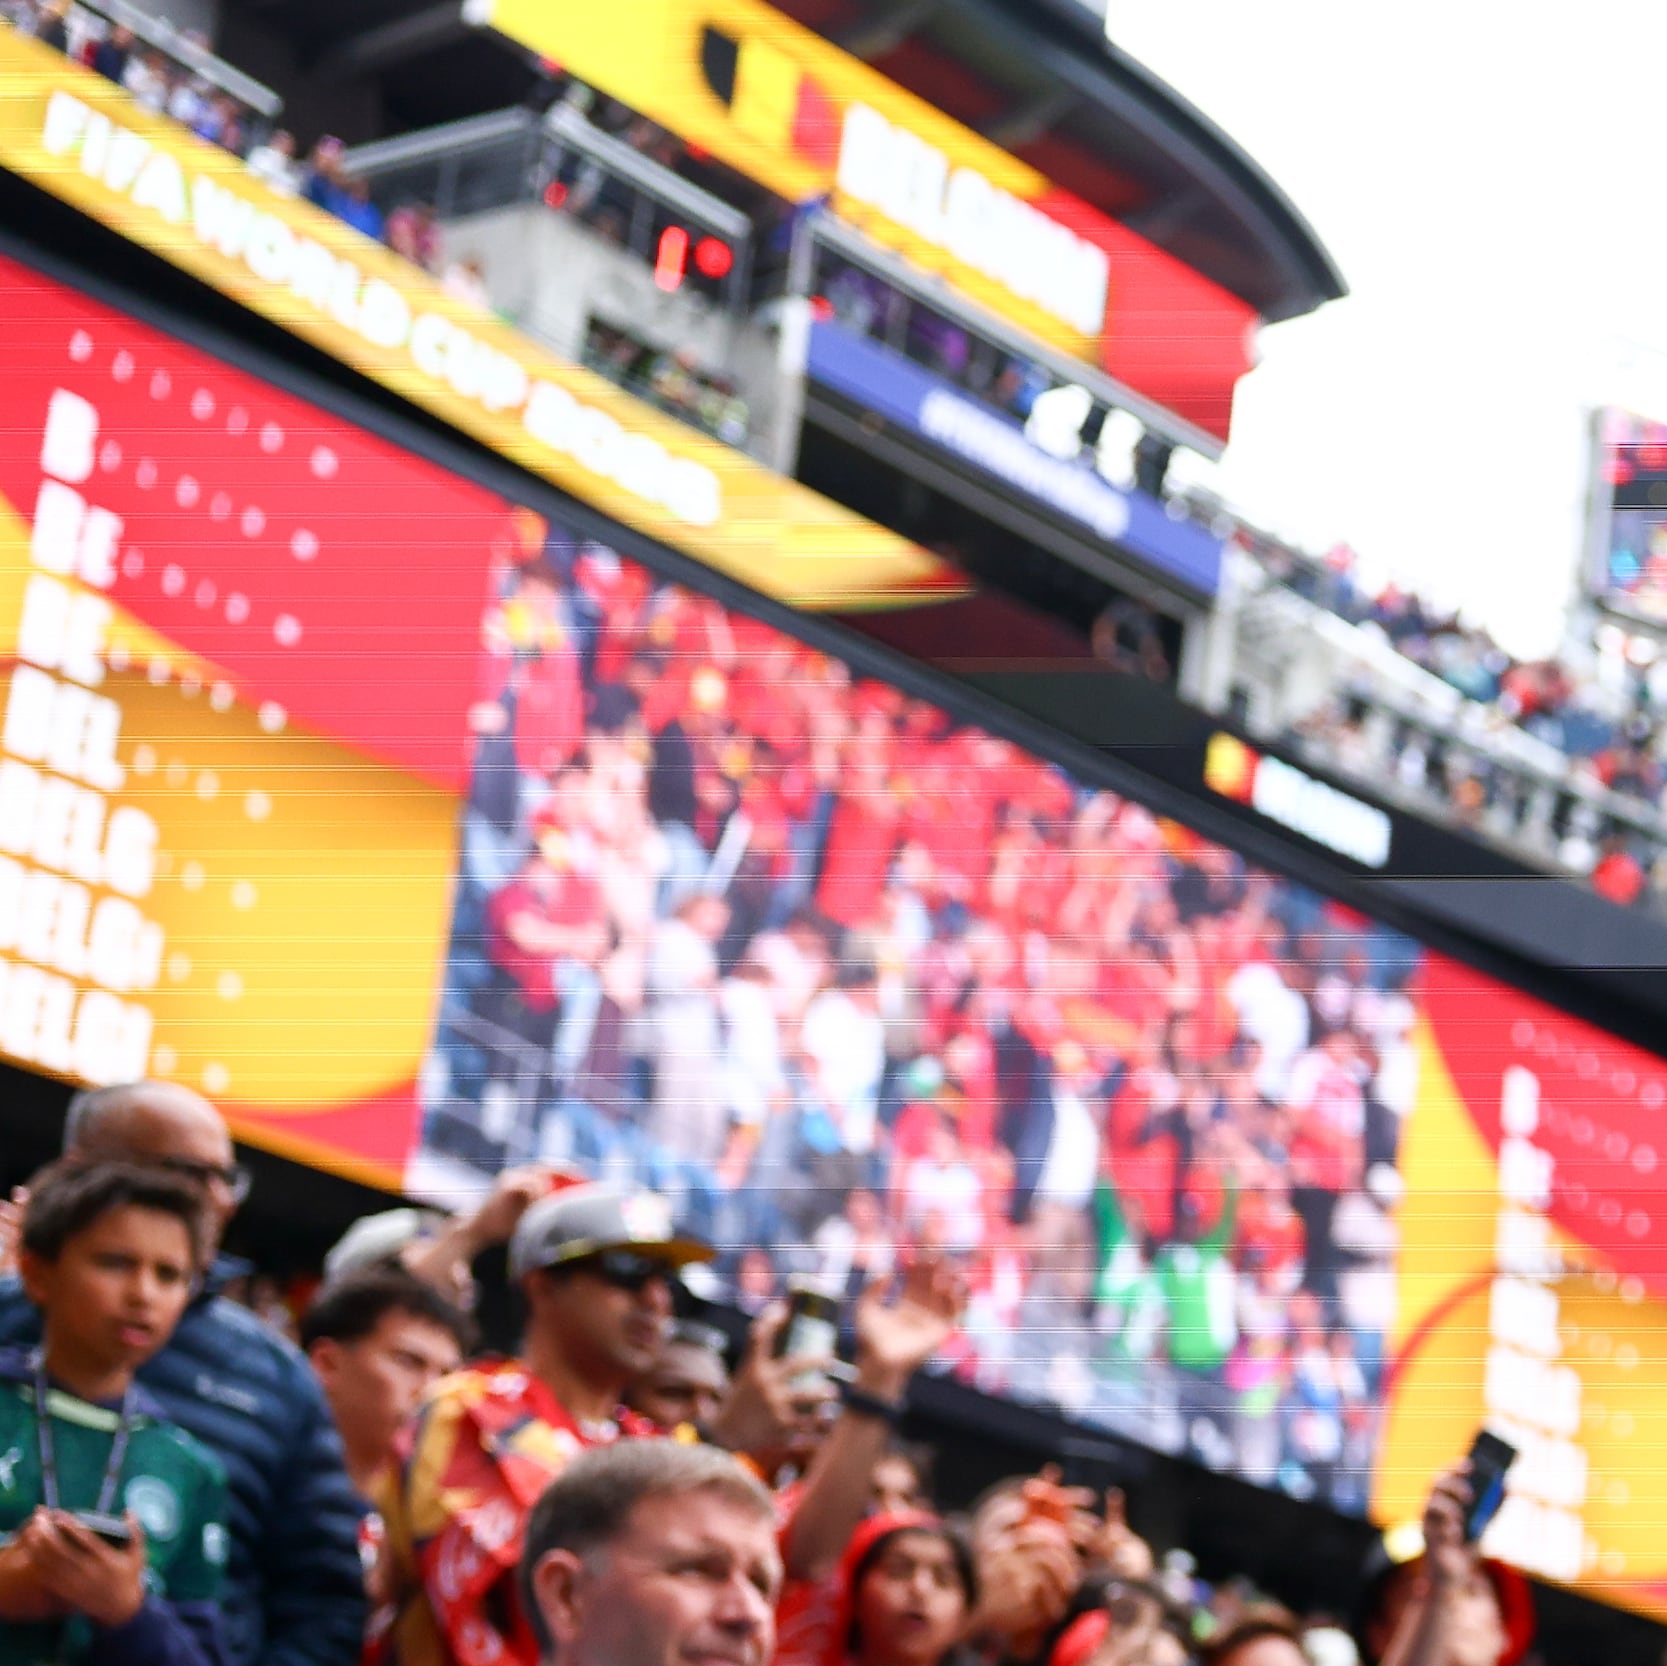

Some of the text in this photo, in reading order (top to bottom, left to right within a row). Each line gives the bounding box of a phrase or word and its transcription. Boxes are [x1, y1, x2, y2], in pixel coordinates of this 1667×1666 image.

[45, 90, 186, 224] FIFA
[192, 175, 411, 348] WORLD
[410, 311, 528, 411] CUP
